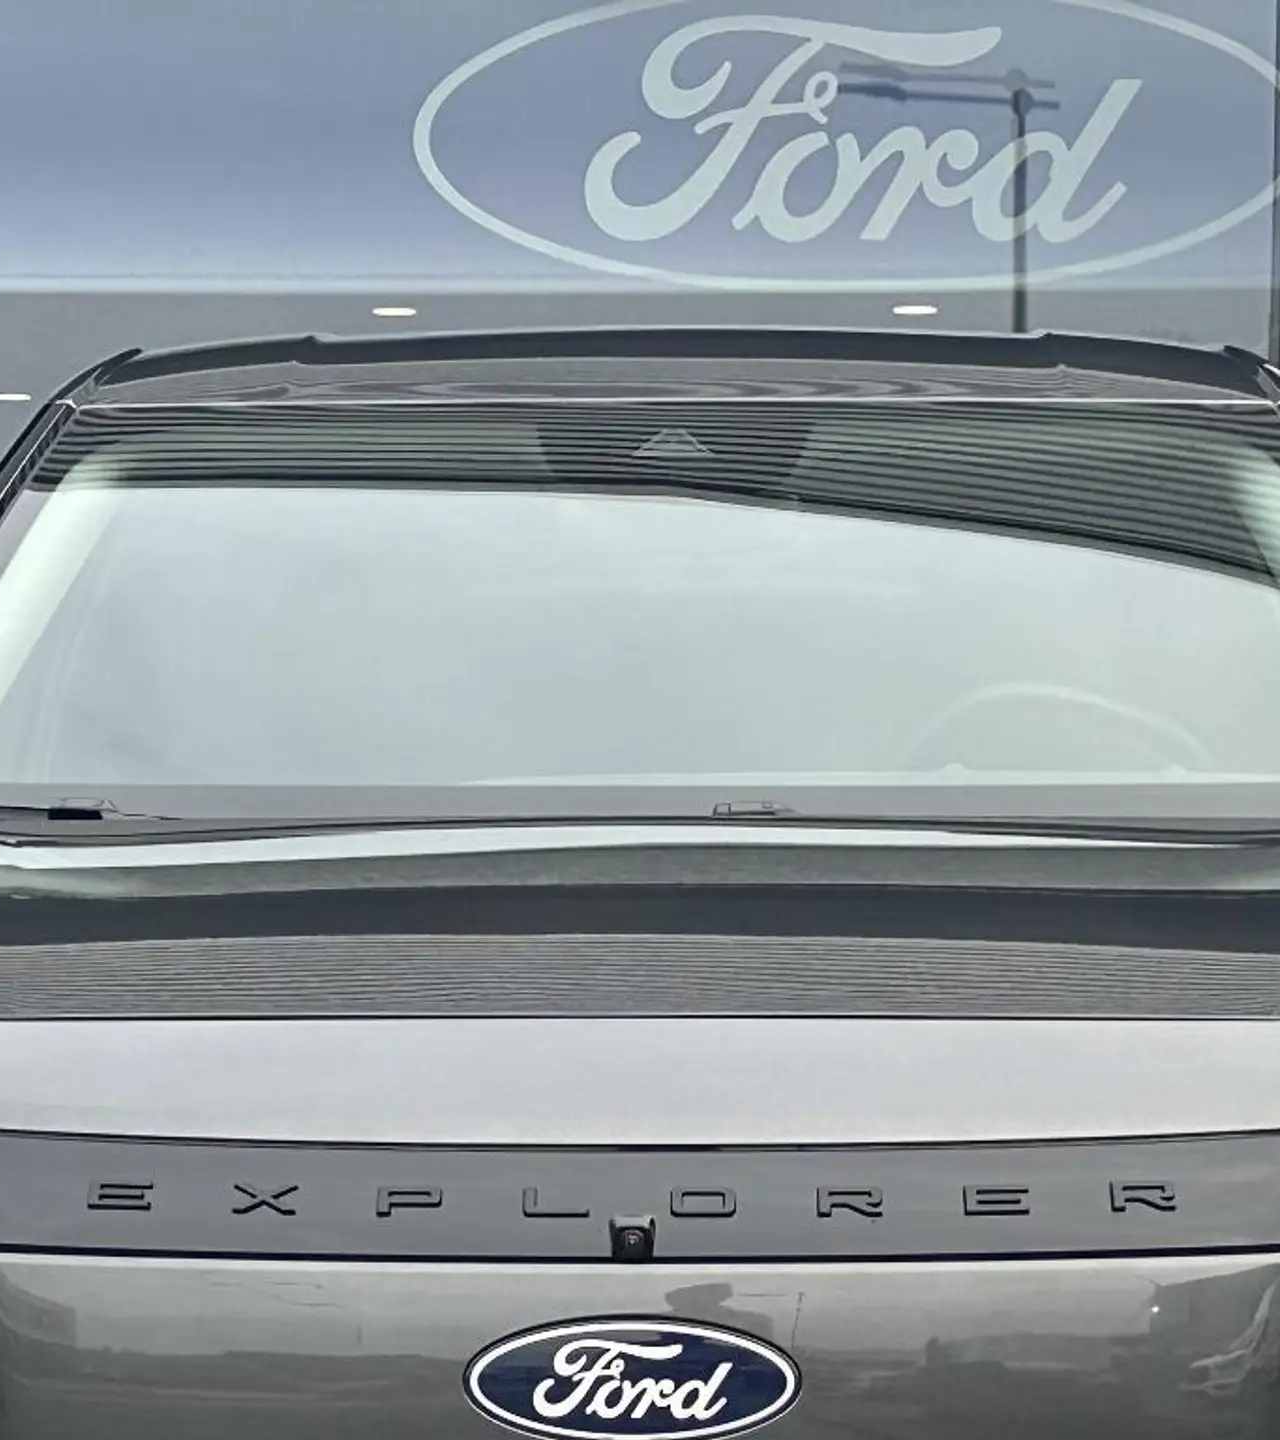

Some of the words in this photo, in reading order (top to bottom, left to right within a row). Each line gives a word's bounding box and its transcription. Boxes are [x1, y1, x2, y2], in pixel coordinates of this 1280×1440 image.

[584, 14, 1142, 243] Ford
[86, 1178, 1178, 1219] EXPLORER
[532, 1338, 733, 1421] Ford
